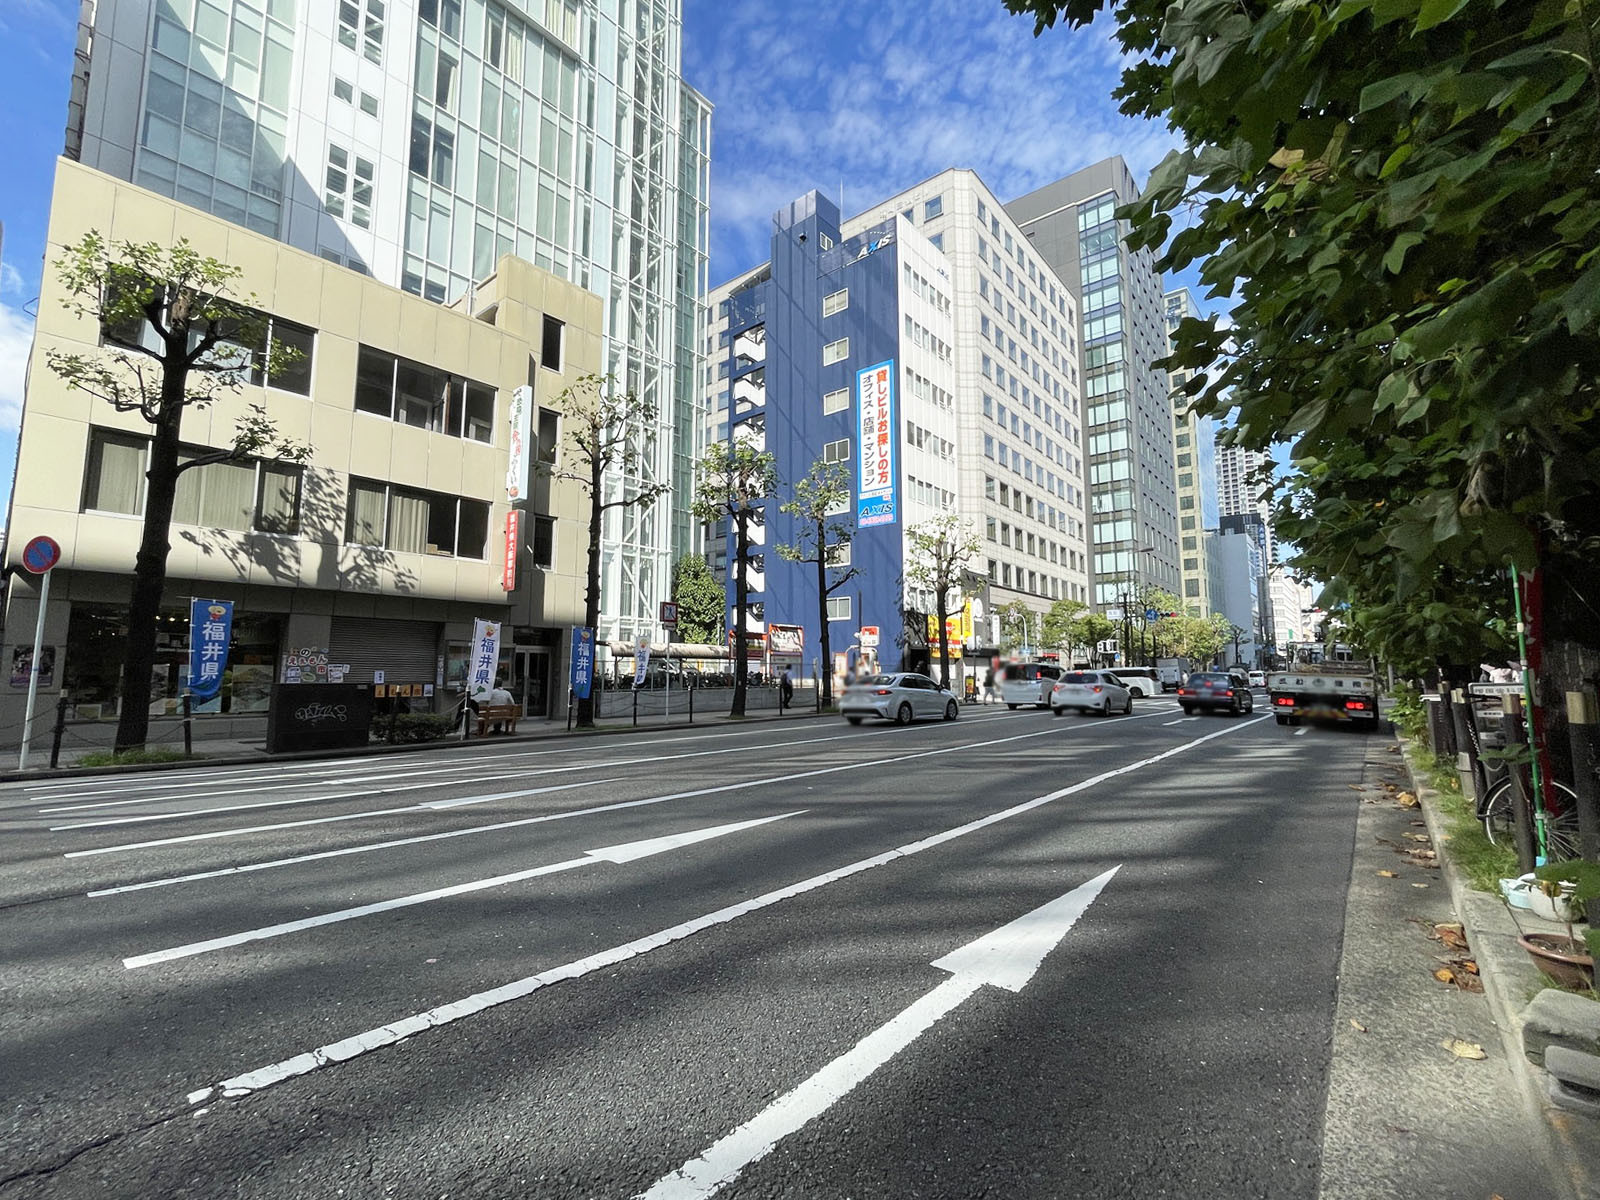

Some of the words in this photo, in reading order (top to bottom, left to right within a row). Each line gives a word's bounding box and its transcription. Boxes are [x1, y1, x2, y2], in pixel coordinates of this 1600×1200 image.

[857, 234, 892, 258] AXIS
[876, 369, 889, 484] 貸しビルお探しの方
[860, 503, 893, 517] AXIS
[201, 621, 226, 681] 福井県
[475, 637, 495, 684] 福井県
[576, 642, 590, 684] 福井県
